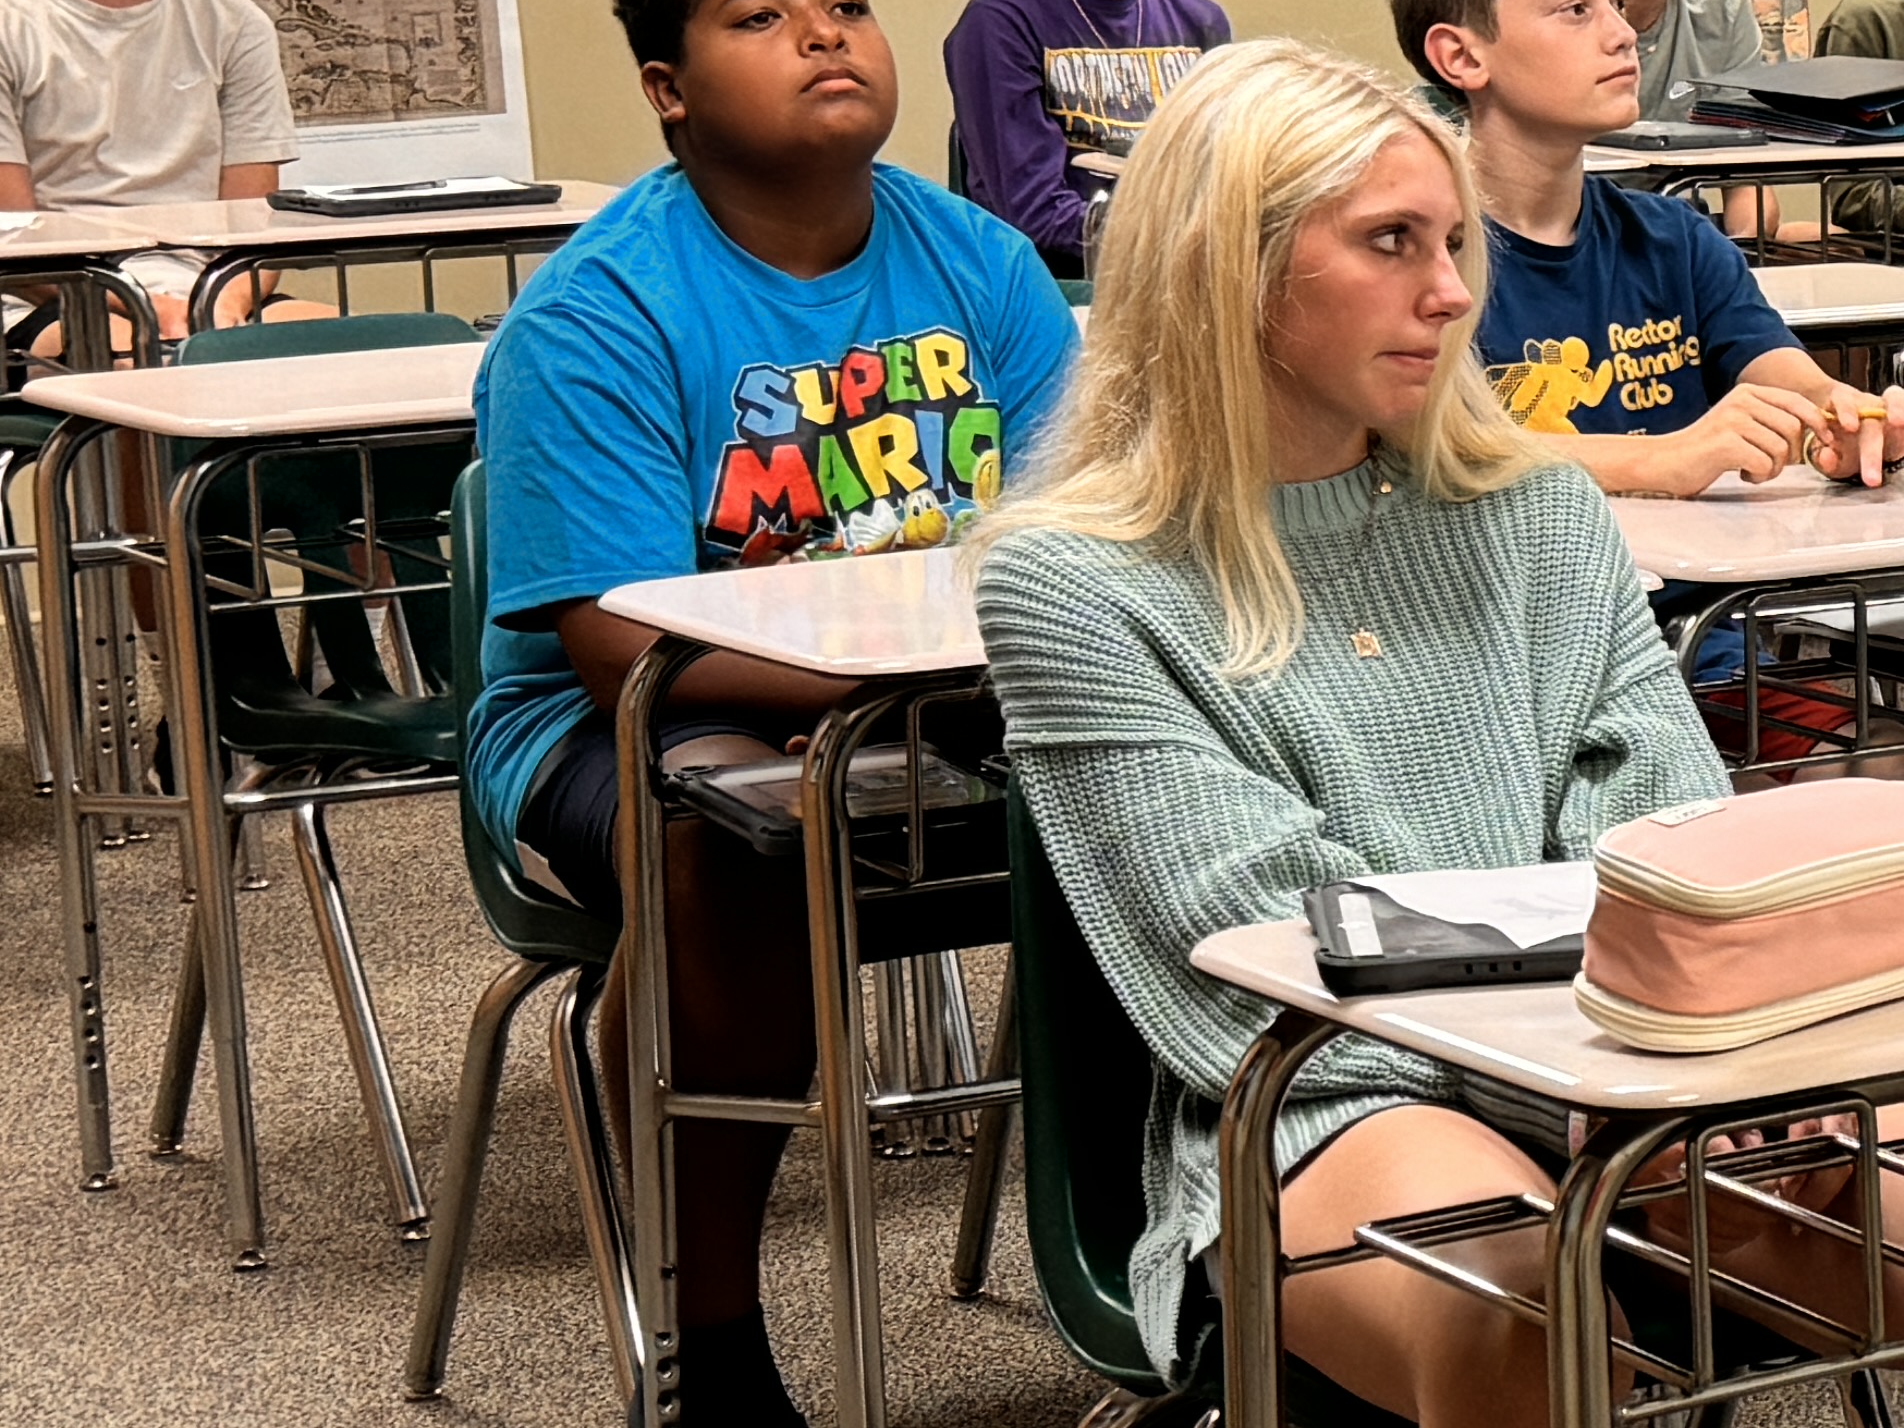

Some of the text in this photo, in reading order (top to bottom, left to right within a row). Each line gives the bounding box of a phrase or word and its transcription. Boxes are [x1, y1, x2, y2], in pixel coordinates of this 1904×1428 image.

[1608, 314, 1682, 352] Rector
[1613, 335, 1701, 383] Running
[737, 332, 975, 438] SUPER
[1620, 377, 1674, 411] Club
[712, 406, 1002, 537] MARIO
